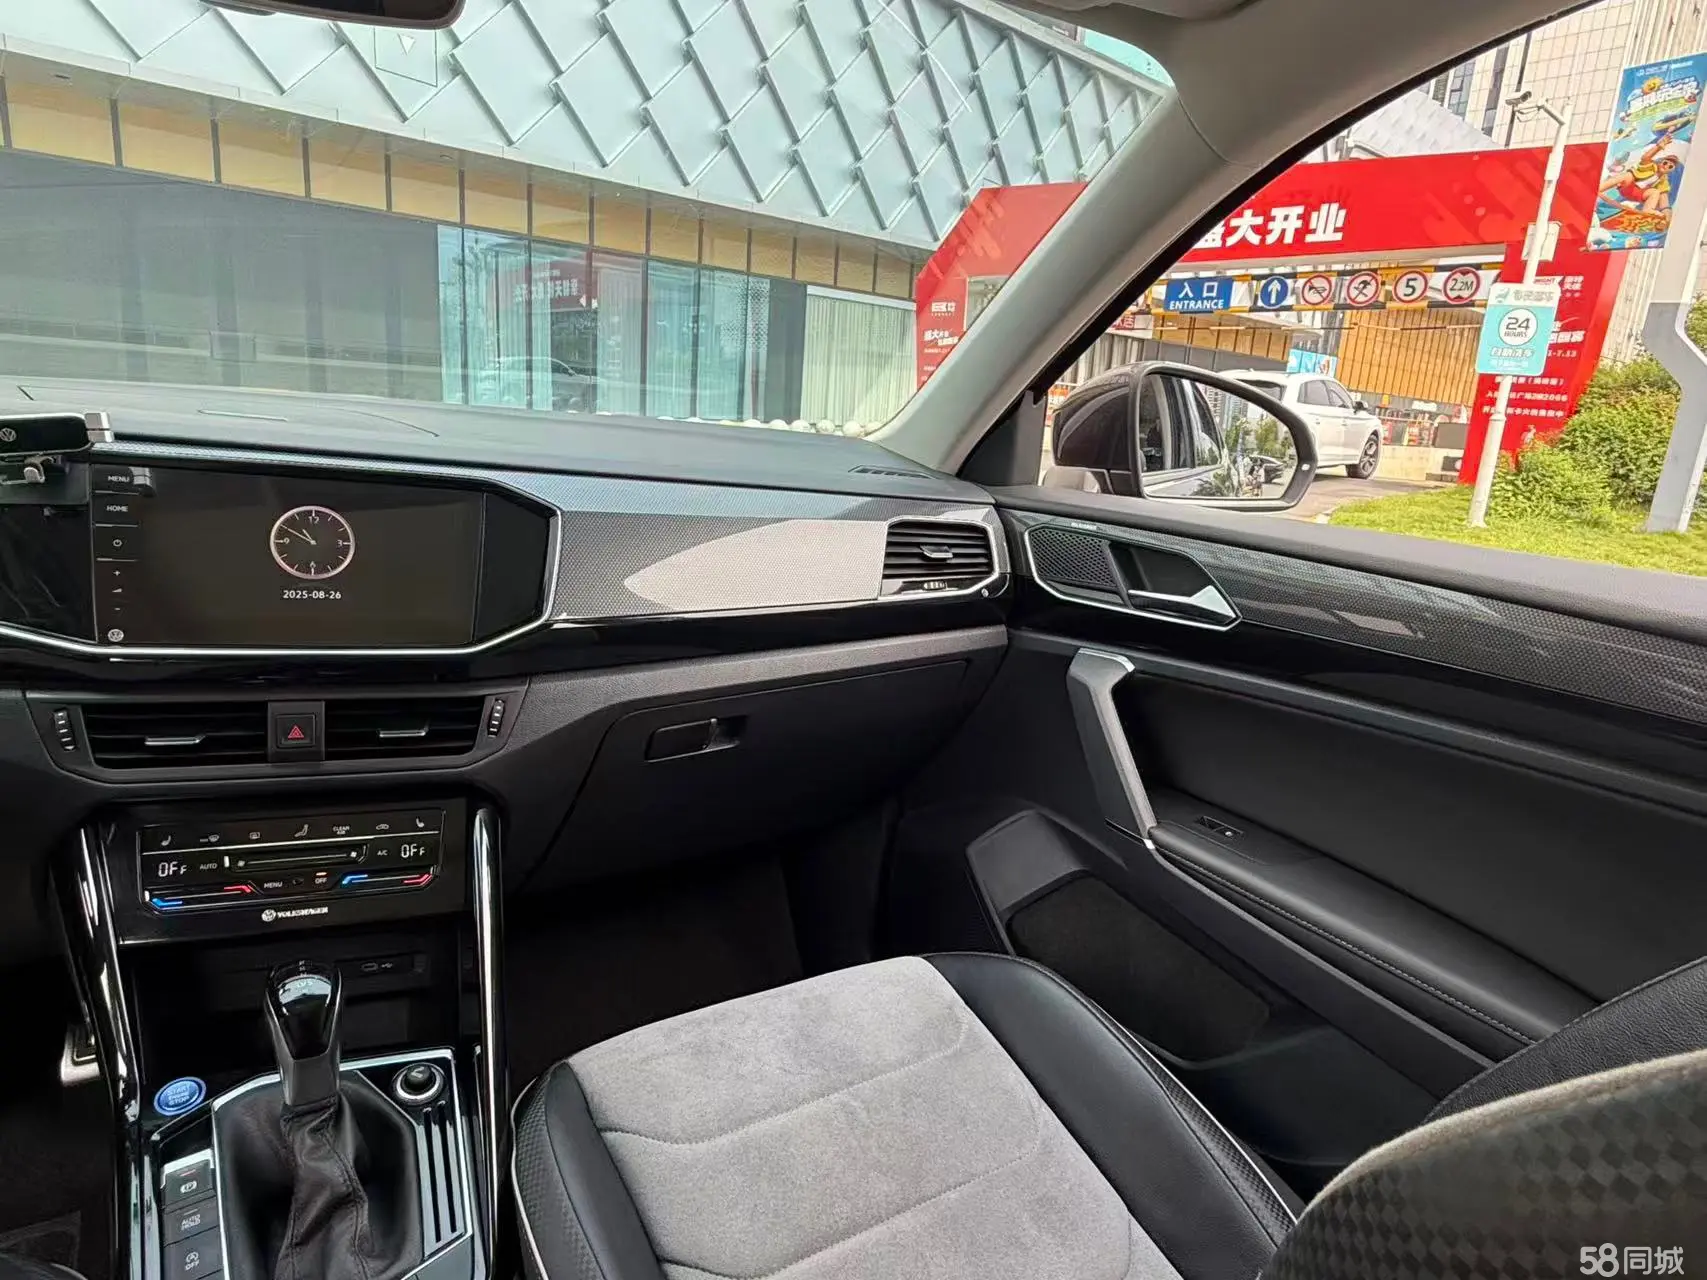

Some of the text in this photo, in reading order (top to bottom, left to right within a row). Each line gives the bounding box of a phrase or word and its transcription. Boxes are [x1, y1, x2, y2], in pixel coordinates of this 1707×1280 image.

[1178, 282, 1218, 297] 入口
[1403, 277, 1418, 297] 5
[1169, 299, 1224, 311] ENTRANCE
[1505, 317, 1531, 331] 24
[107, 475, 130, 483] MENU
[106, 504, 129, 512] HOME
[308, 516, 319, 524] 12
[337, 539, 343, 548] 3
[282, 590, 342, 599] 2025-08-26
[199, 862, 218, 870] AUTO
[263, 881, 283, 889] MENU
[185, 1259, 200, 1271] OFF
